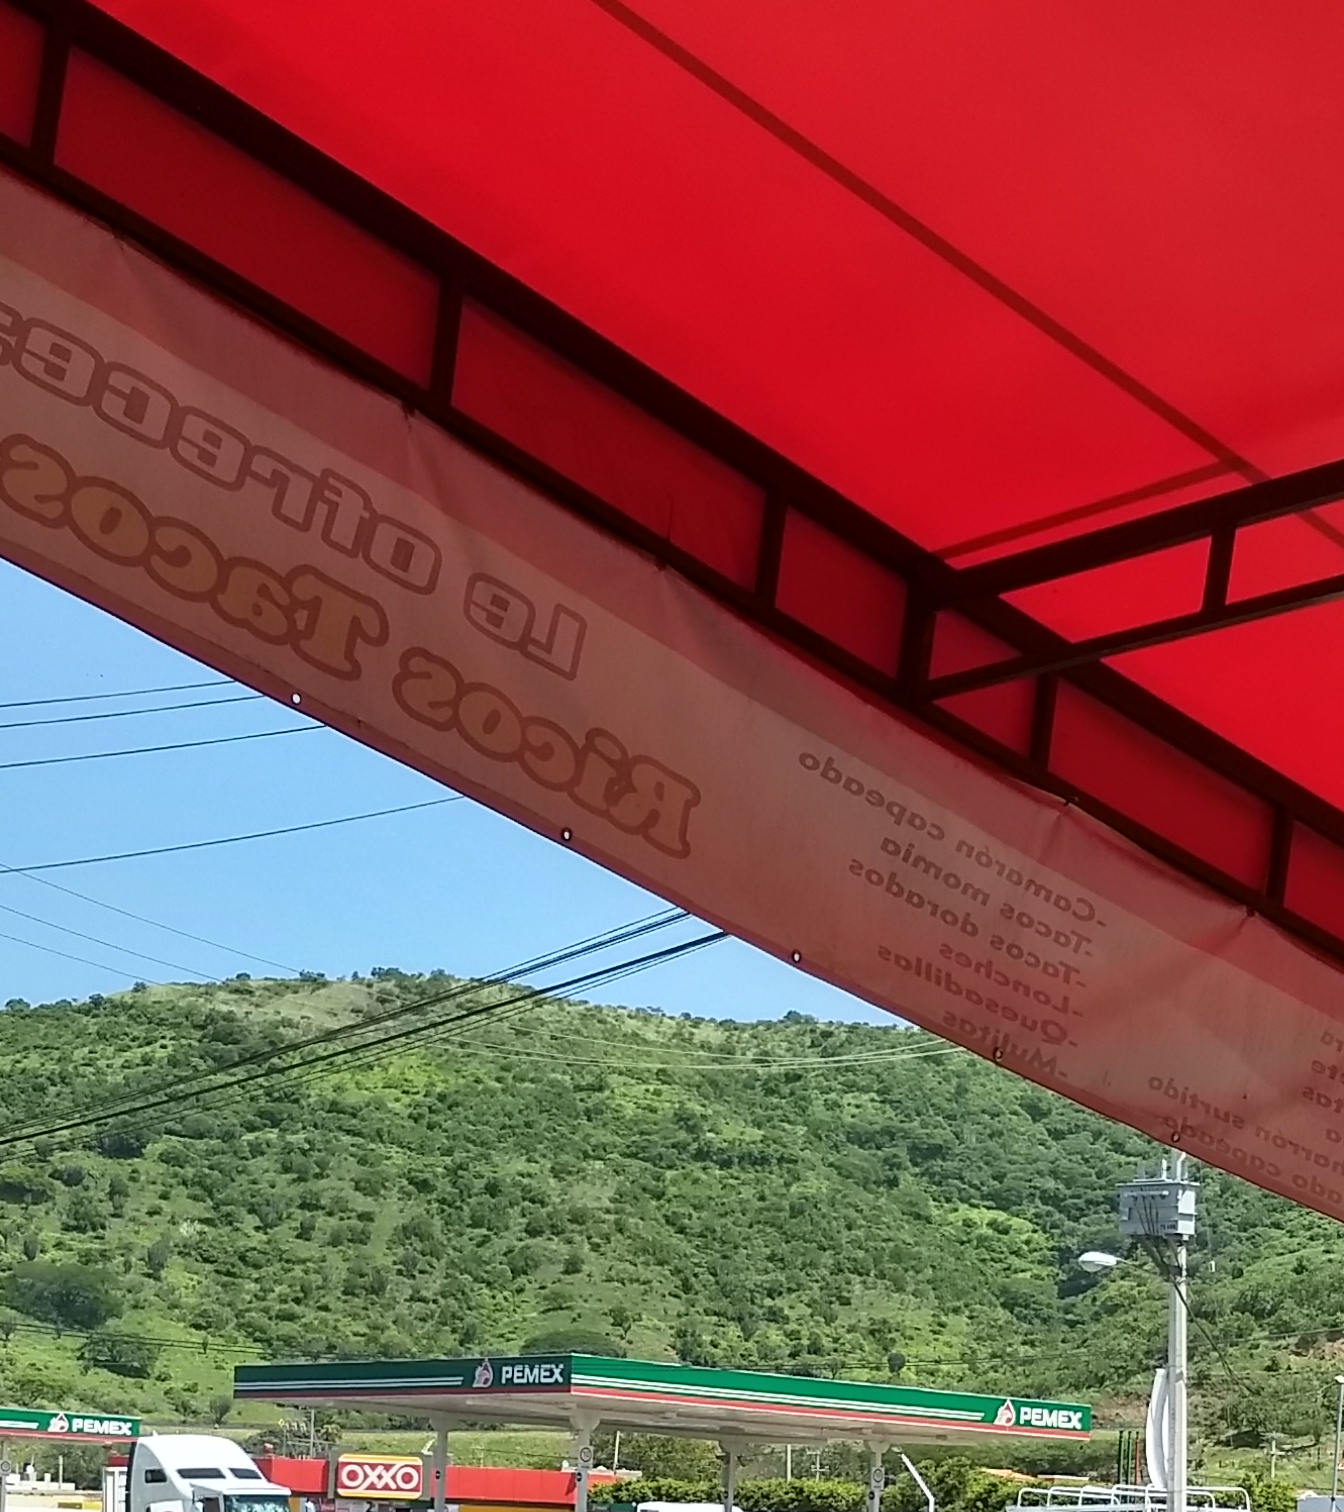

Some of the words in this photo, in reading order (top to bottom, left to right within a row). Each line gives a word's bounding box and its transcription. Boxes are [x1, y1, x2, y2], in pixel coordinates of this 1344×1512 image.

[500, 1363, 565, 1385] PEMEX
[72, 1417, 133, 1437] PEMEX
[1019, 1406, 1083, 1431] PEMEX
[341, 1464, 419, 1491] OXXO
